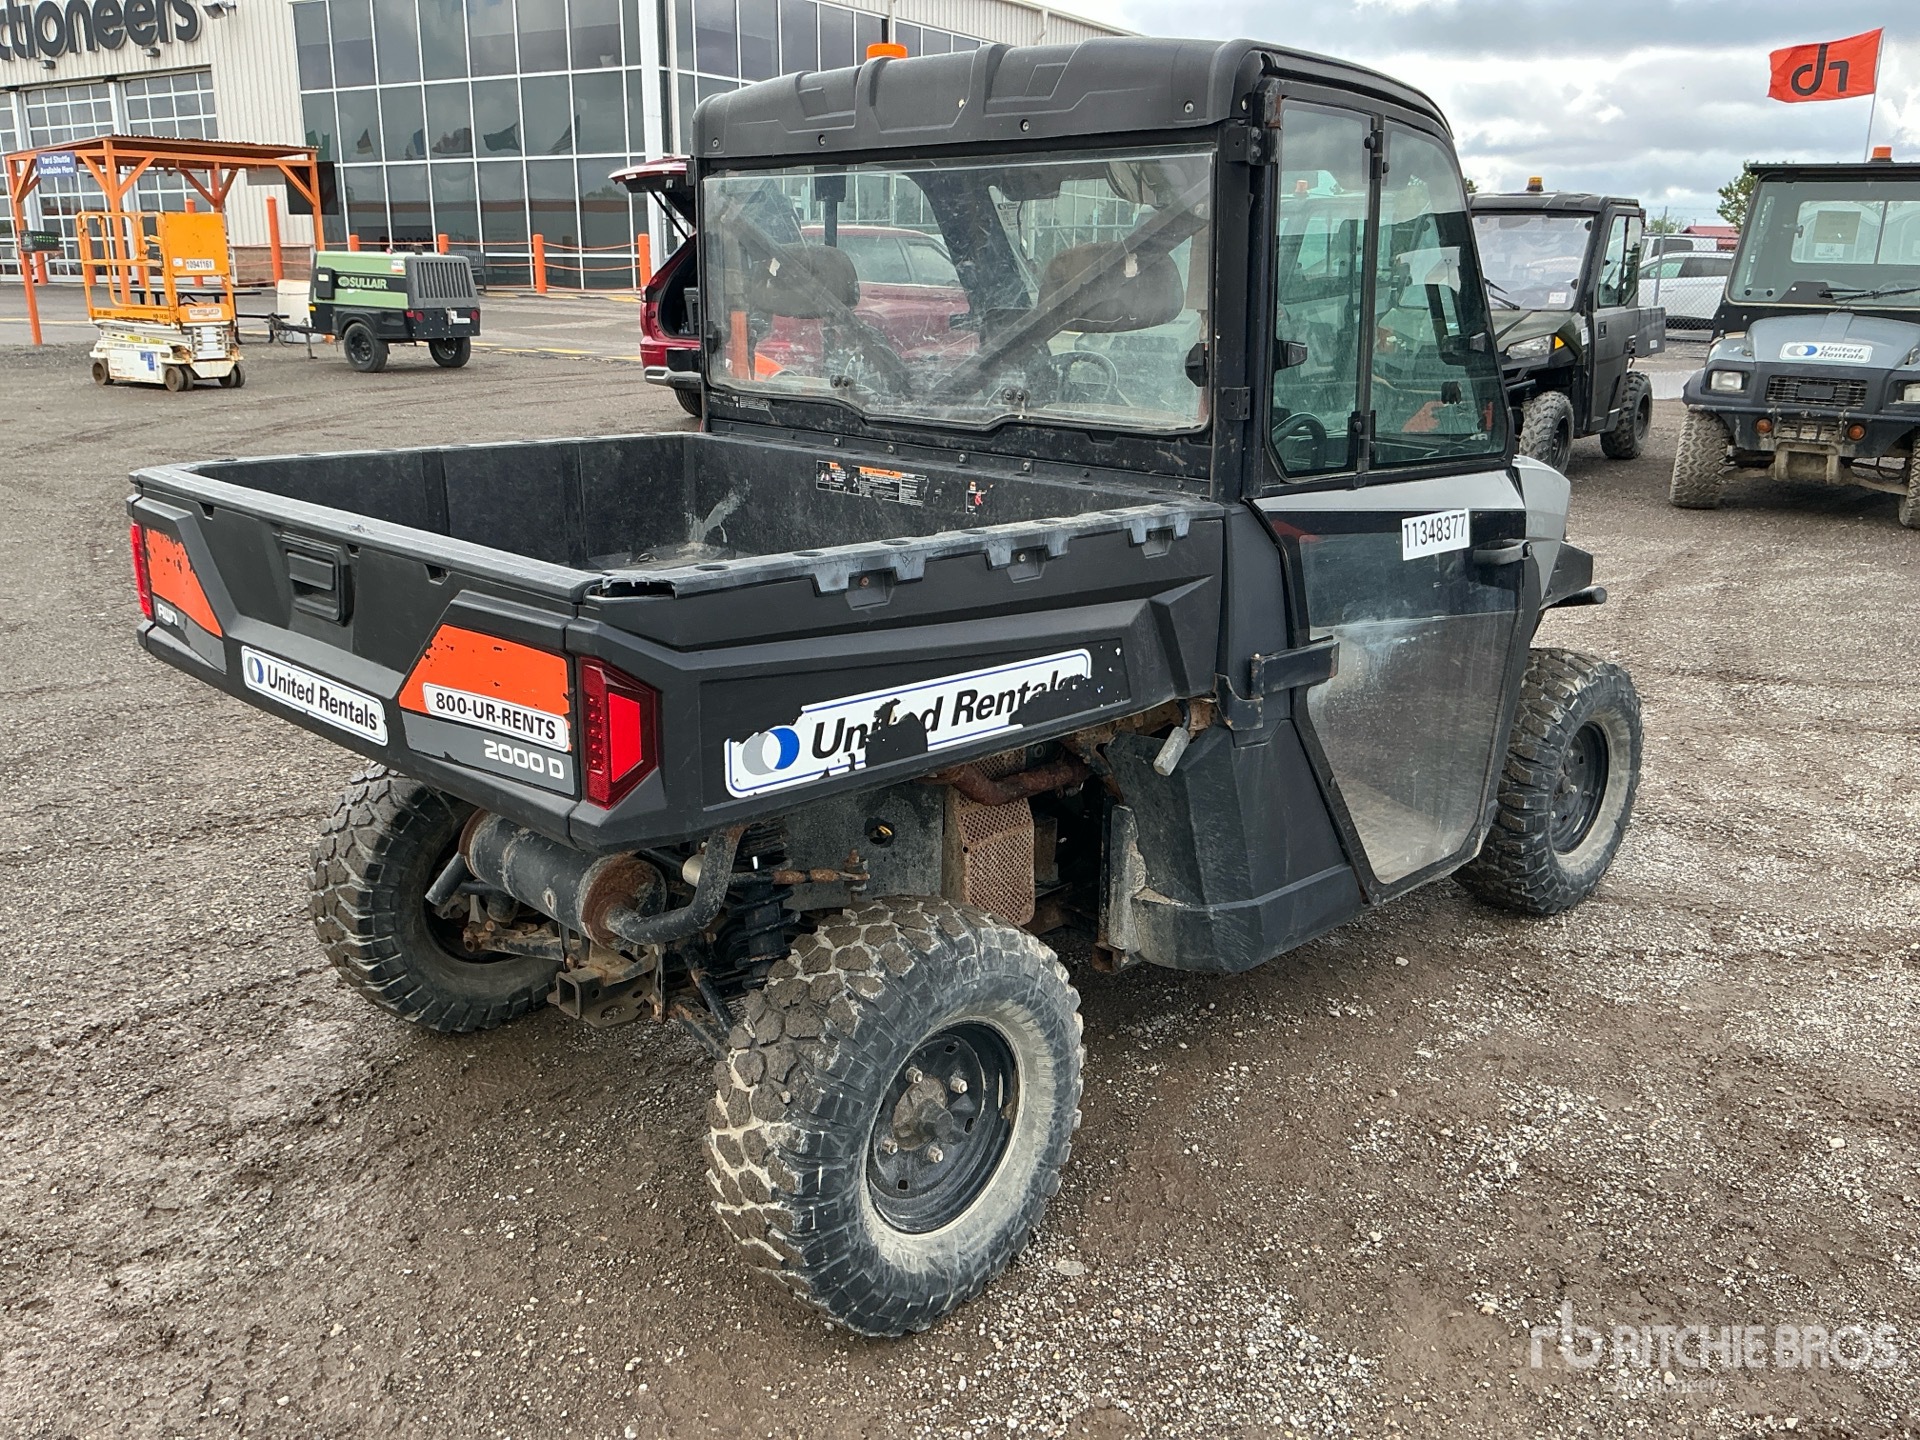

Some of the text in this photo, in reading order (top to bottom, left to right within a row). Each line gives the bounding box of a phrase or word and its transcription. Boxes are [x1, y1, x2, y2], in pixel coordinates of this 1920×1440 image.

[53, 154, 71, 164] Shuttle
[40, 165, 74, 175] Available Here
[349, 277, 388, 289] SULLAIR
[1818, 350, 1865, 360] Rentals
[1820, 345, 1863, 354] United
[1404, 513, 1466, 548] 11348377
[267, 664, 378, 731] United Rentals
[436, 692, 556, 740] 800-UR-RENTS
[483, 739, 565, 780] 2000 D
